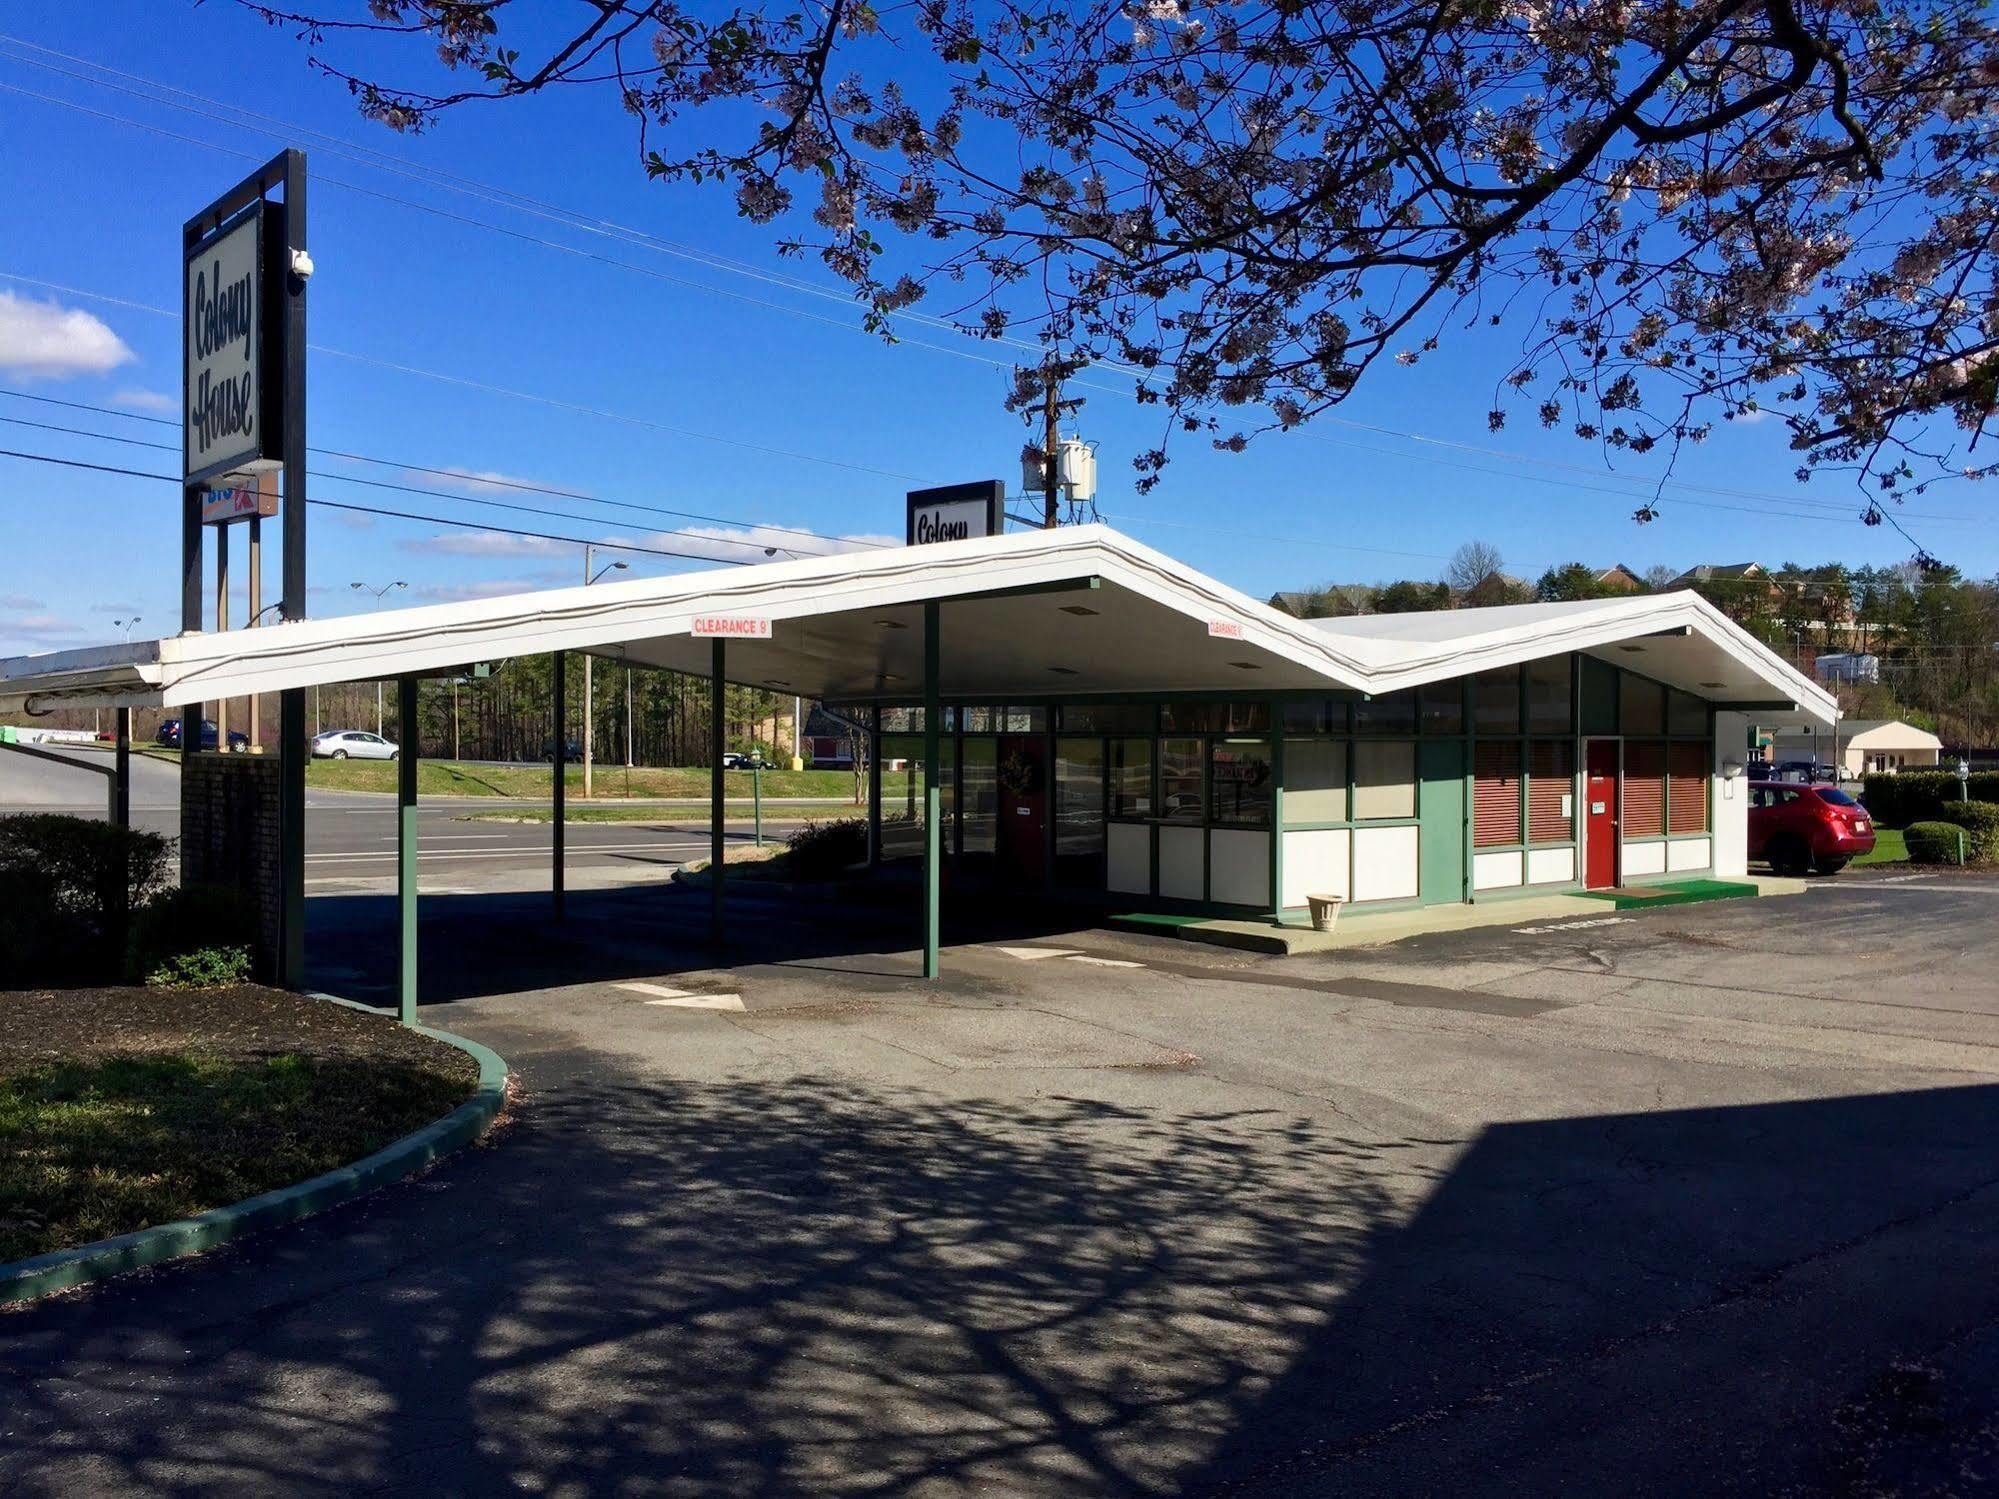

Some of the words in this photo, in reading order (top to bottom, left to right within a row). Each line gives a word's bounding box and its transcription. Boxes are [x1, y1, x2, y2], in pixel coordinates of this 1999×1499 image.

[195, 260, 251, 361] Colony
[192, 368, 253, 454] House
[694, 618, 757, 634] CLEARANCE
[759, 619, 767, 634] 9
